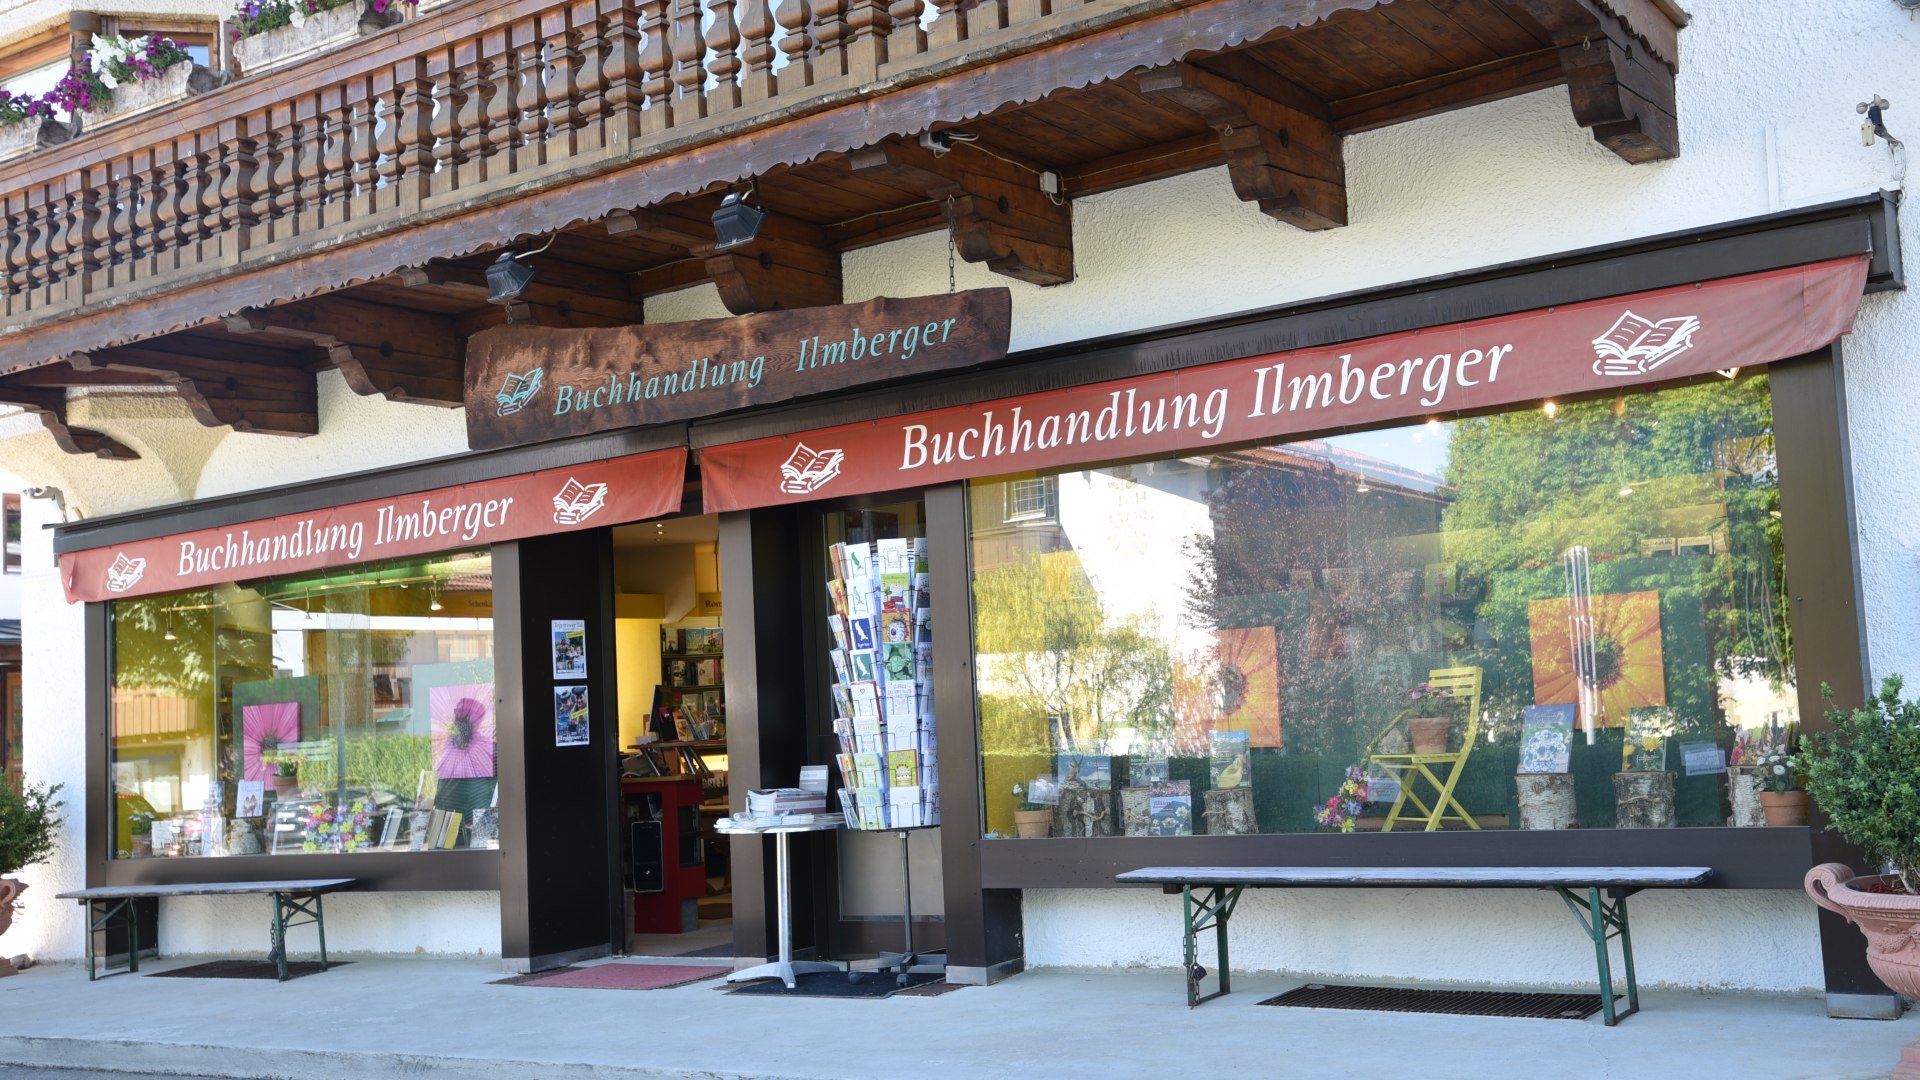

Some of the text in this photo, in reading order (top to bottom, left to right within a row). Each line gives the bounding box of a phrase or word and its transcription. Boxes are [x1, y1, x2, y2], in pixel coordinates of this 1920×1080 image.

[553, 317, 958, 417] Buchhandlung Ilmberger
[898, 343, 1514, 471] Buchhandlung Ilmberger
[176, 496, 514, 577] Buchhandlung Ilmberger
